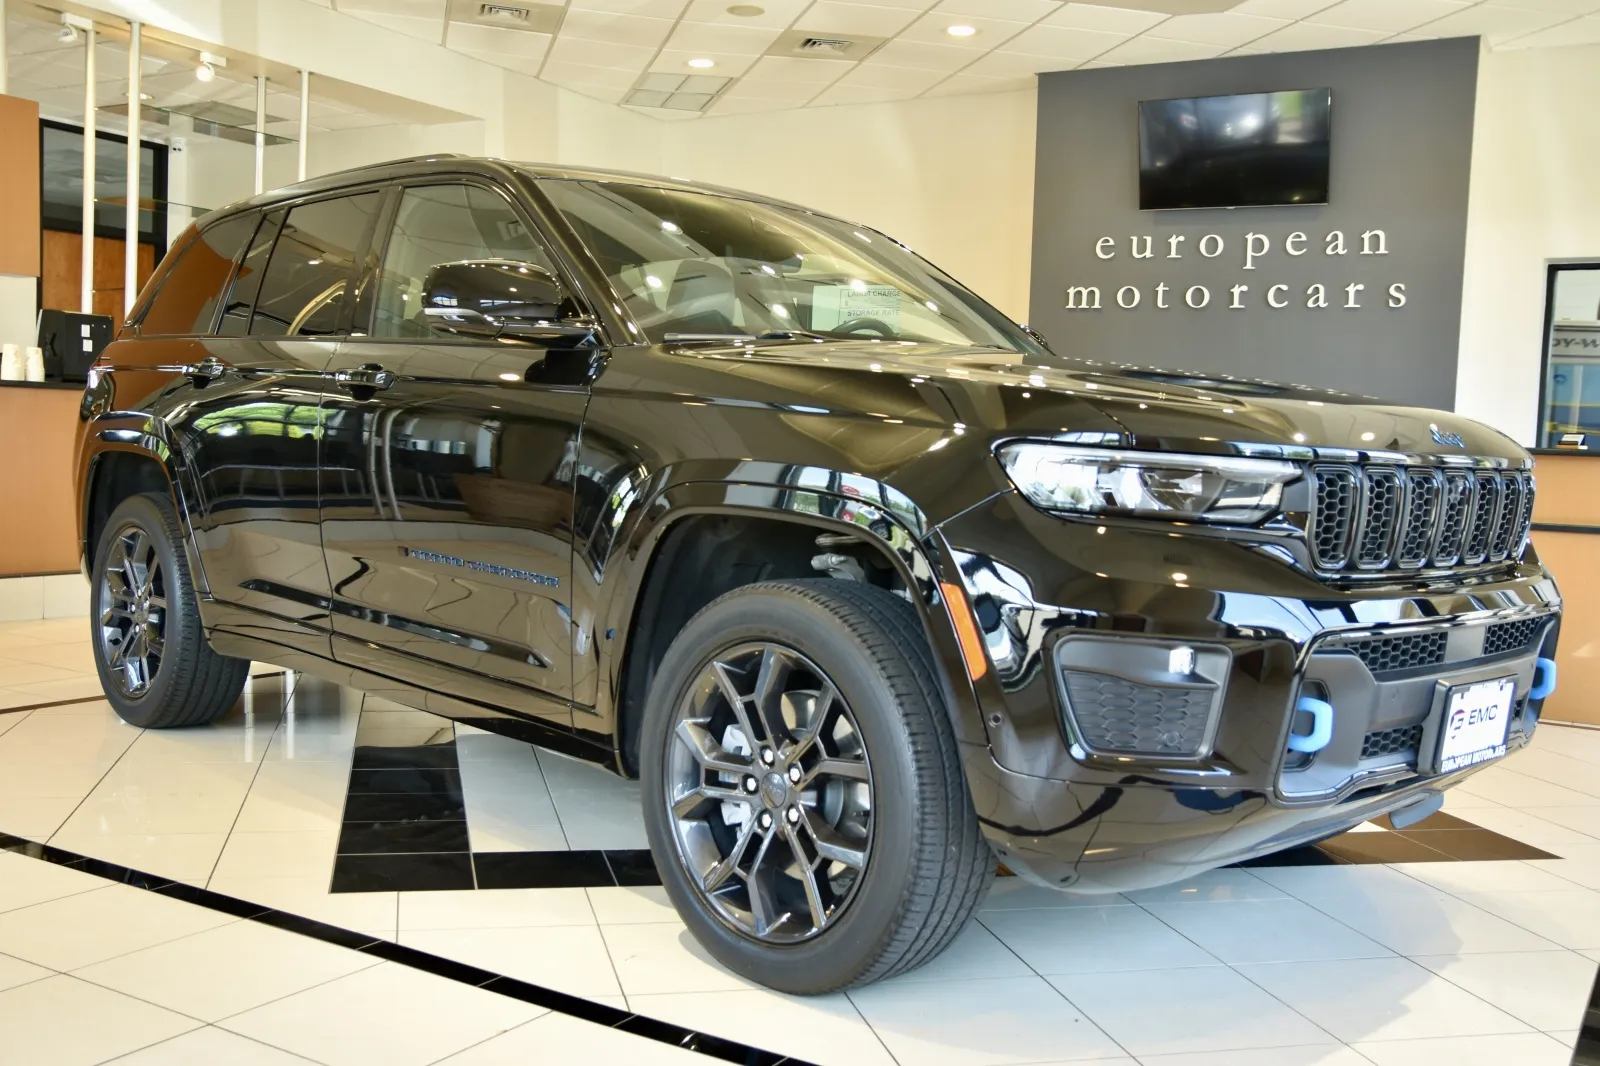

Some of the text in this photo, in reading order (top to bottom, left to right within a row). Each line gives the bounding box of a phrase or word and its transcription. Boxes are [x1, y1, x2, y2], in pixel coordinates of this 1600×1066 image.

[1095, 227, 1389, 270] european
[1064, 281, 1407, 309] motorcars
[847, 309, 901, 317] STORAGE RATE
[1468, 704, 1498, 725] EMC
